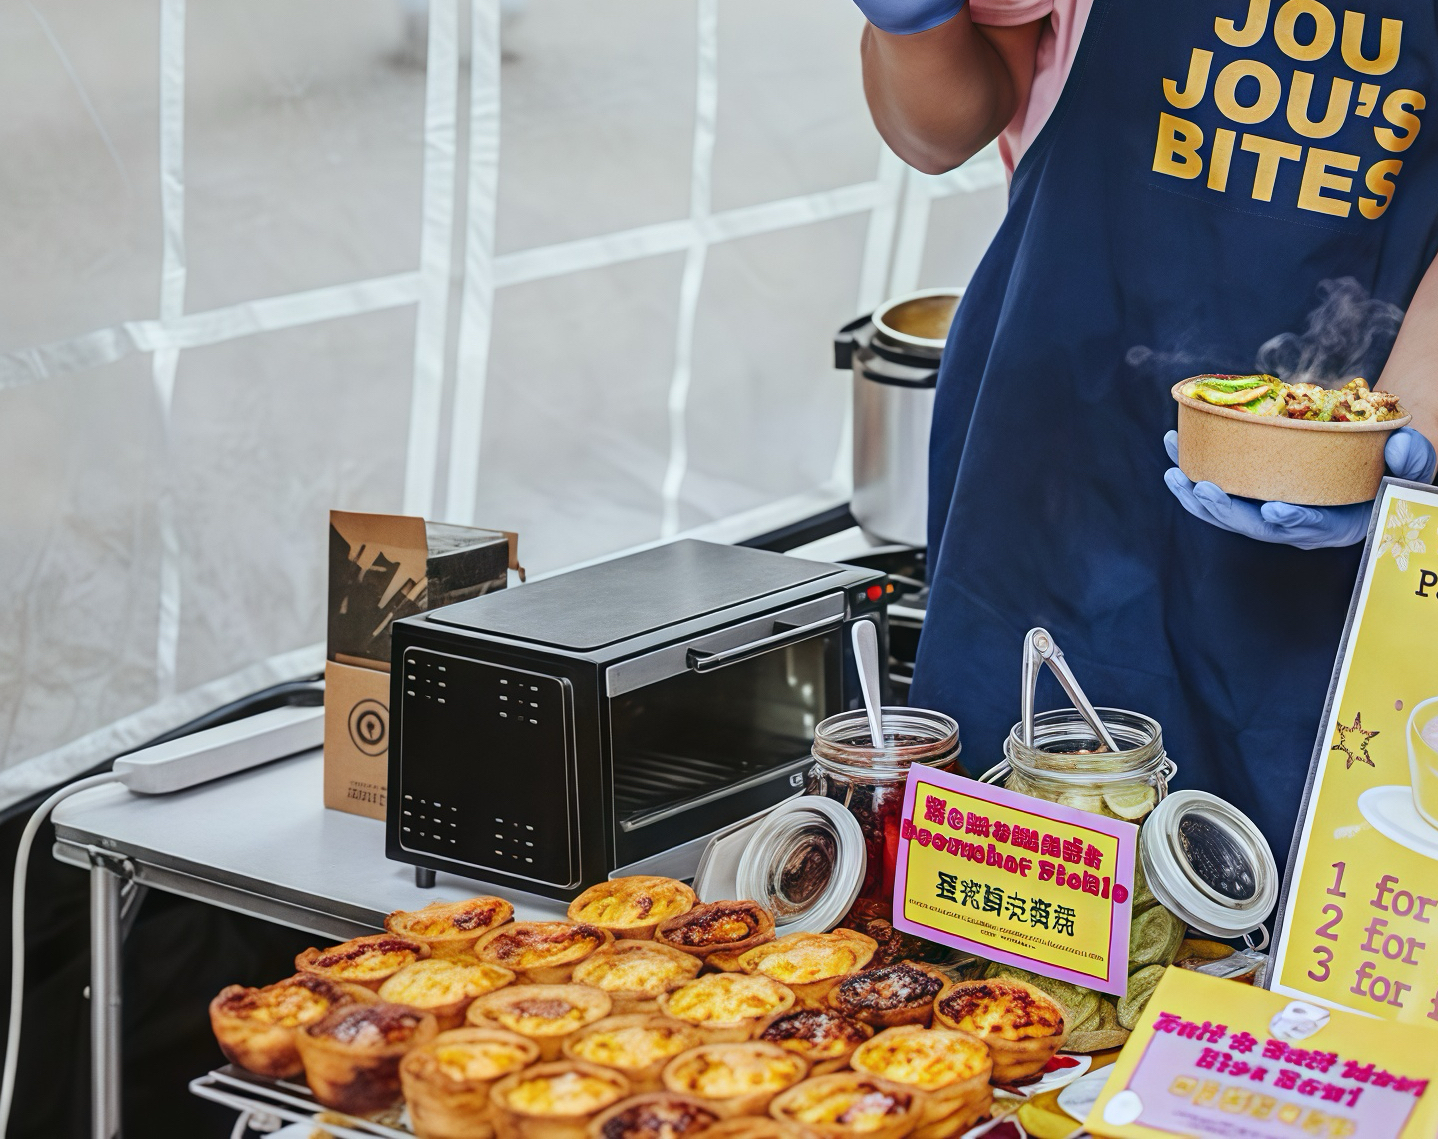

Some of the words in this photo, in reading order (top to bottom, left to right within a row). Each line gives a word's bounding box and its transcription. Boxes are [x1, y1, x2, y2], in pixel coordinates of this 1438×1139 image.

[1162, 48, 1426, 153] JOU'S
[1152, 112, 1403, 220] BITES
[1326, 861, 1346, 898] 1
[1370, 875, 1438, 923] for
[1315, 903, 1344, 941] 2
[1360, 917, 1426, 966] for
[1307, 945, 1334, 982] 3
[1350, 961, 1412, 1008] for
